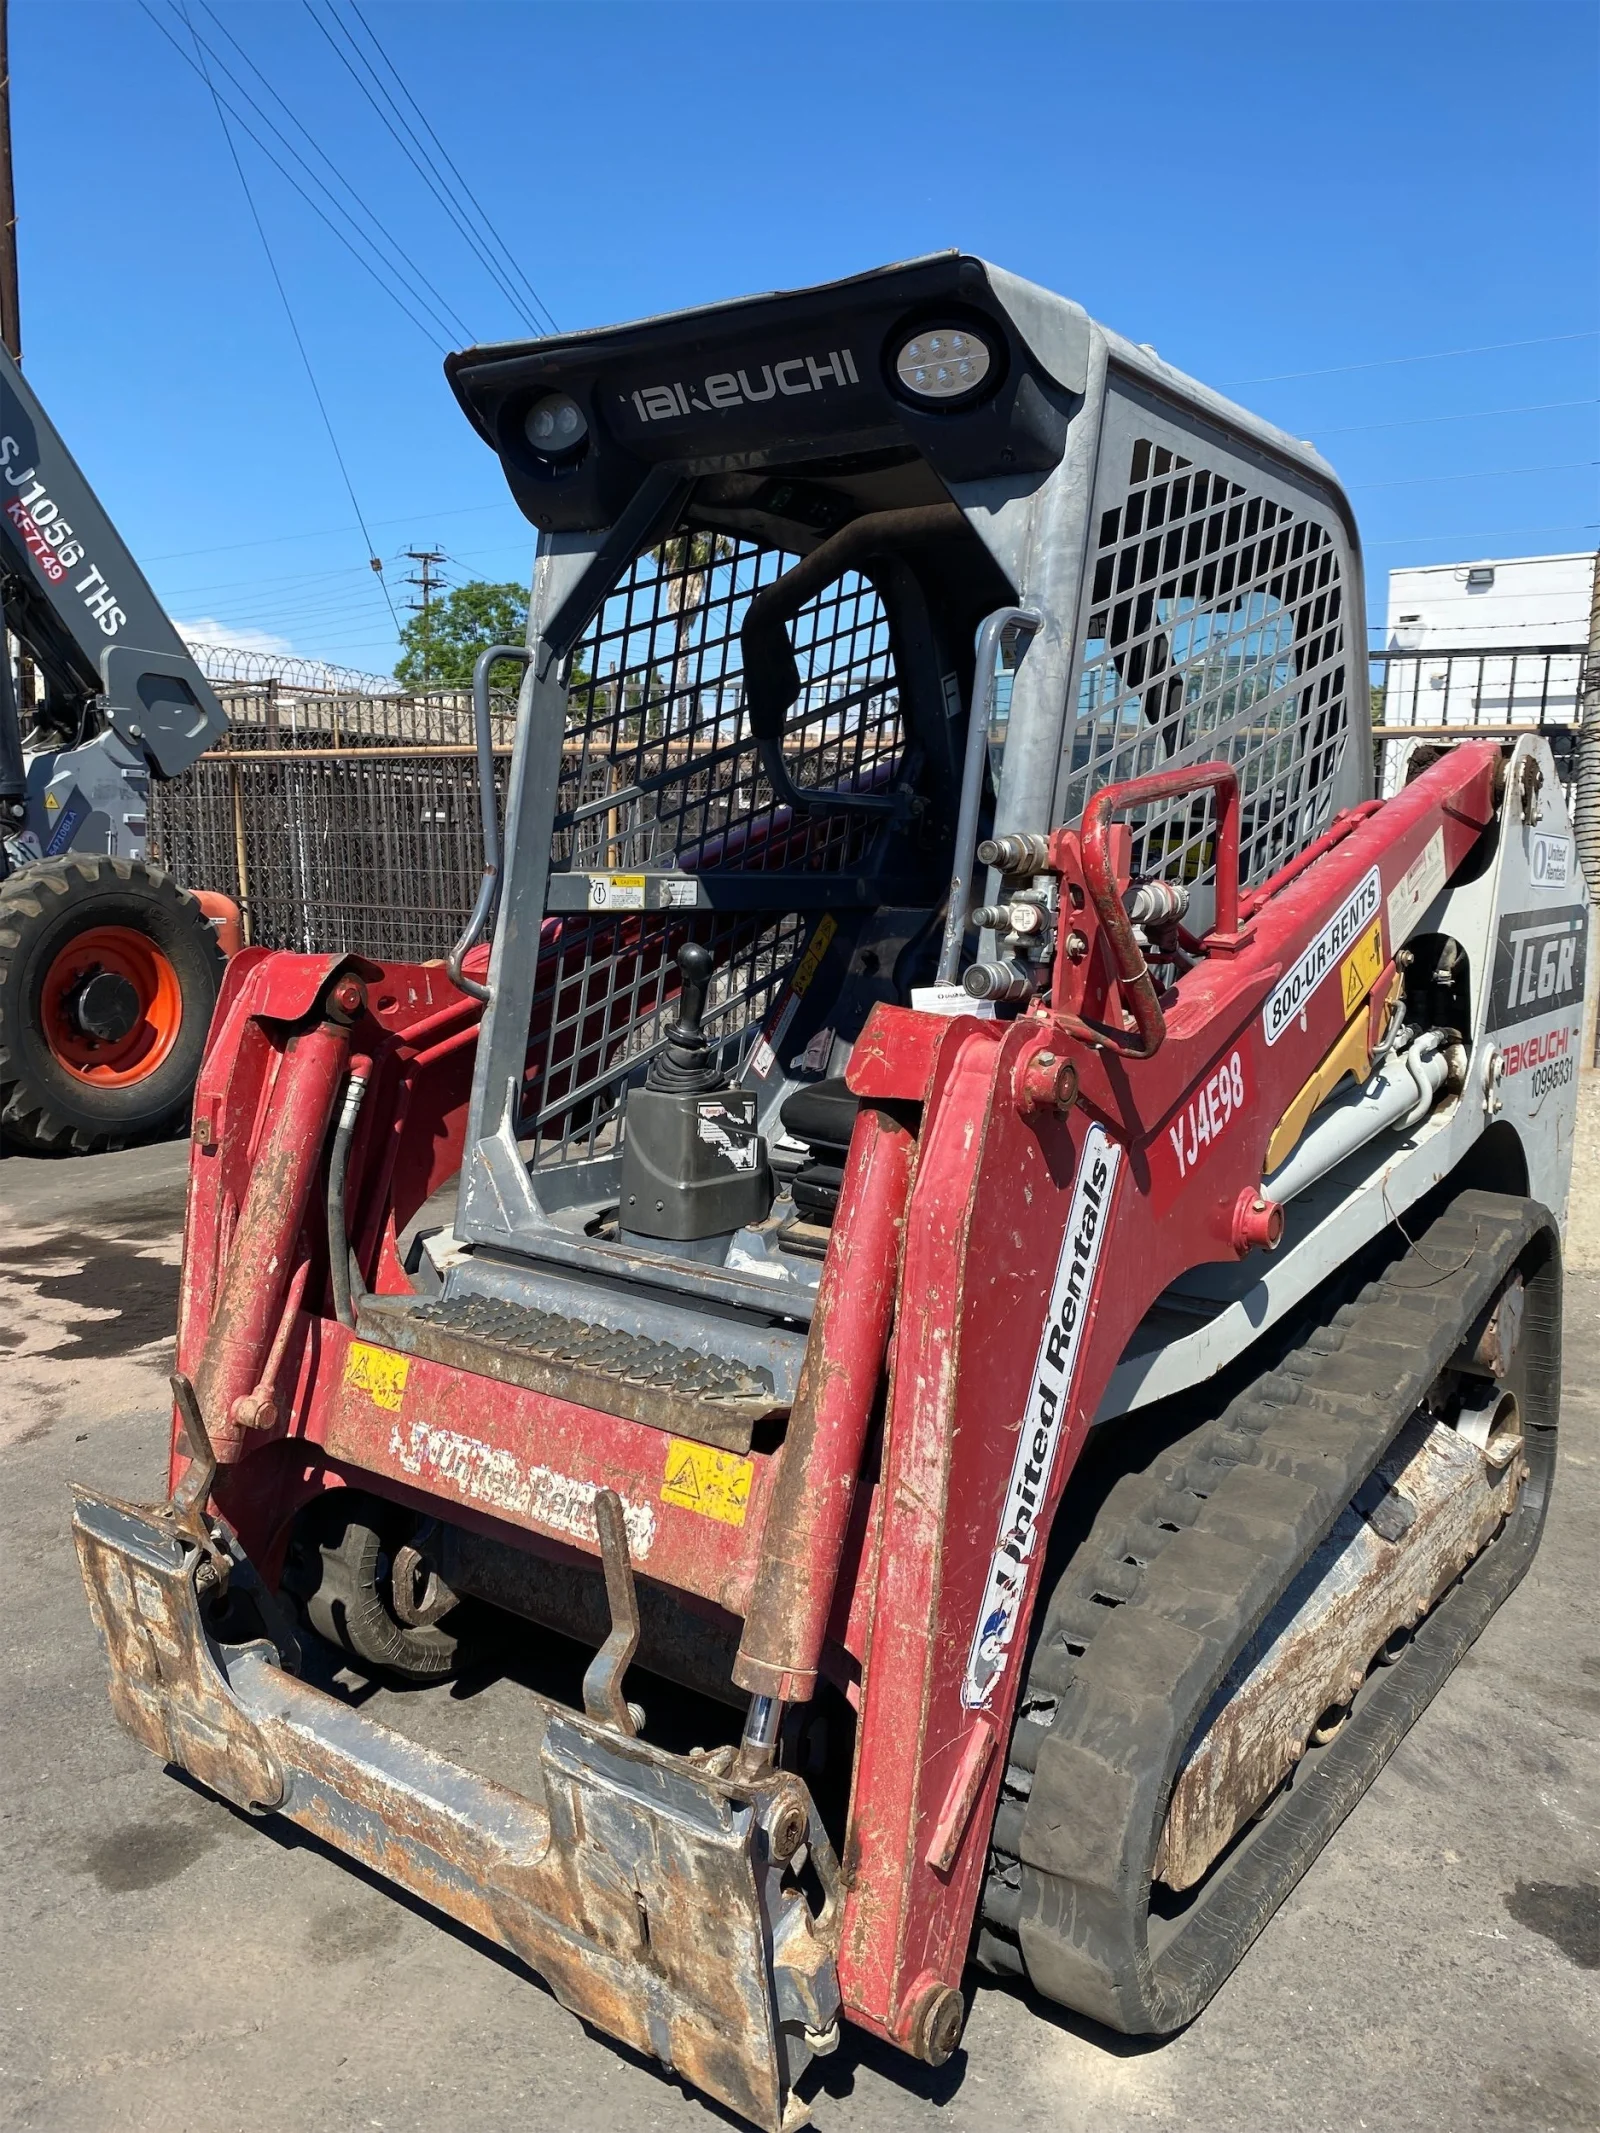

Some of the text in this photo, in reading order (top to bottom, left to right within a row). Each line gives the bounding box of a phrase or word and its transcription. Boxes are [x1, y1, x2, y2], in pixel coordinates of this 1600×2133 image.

[0, 435, 127, 637] SJ1056 THS
[7, 502, 64, 580] KF7T49
[1272, 880, 1375, 1029] 800-UR-RENTS
[1507, 919, 1583, 1009] TL6R
[1169, 1051, 1245, 1178] YJ4E98
[1045, 1158, 1109, 1376] Rentals
